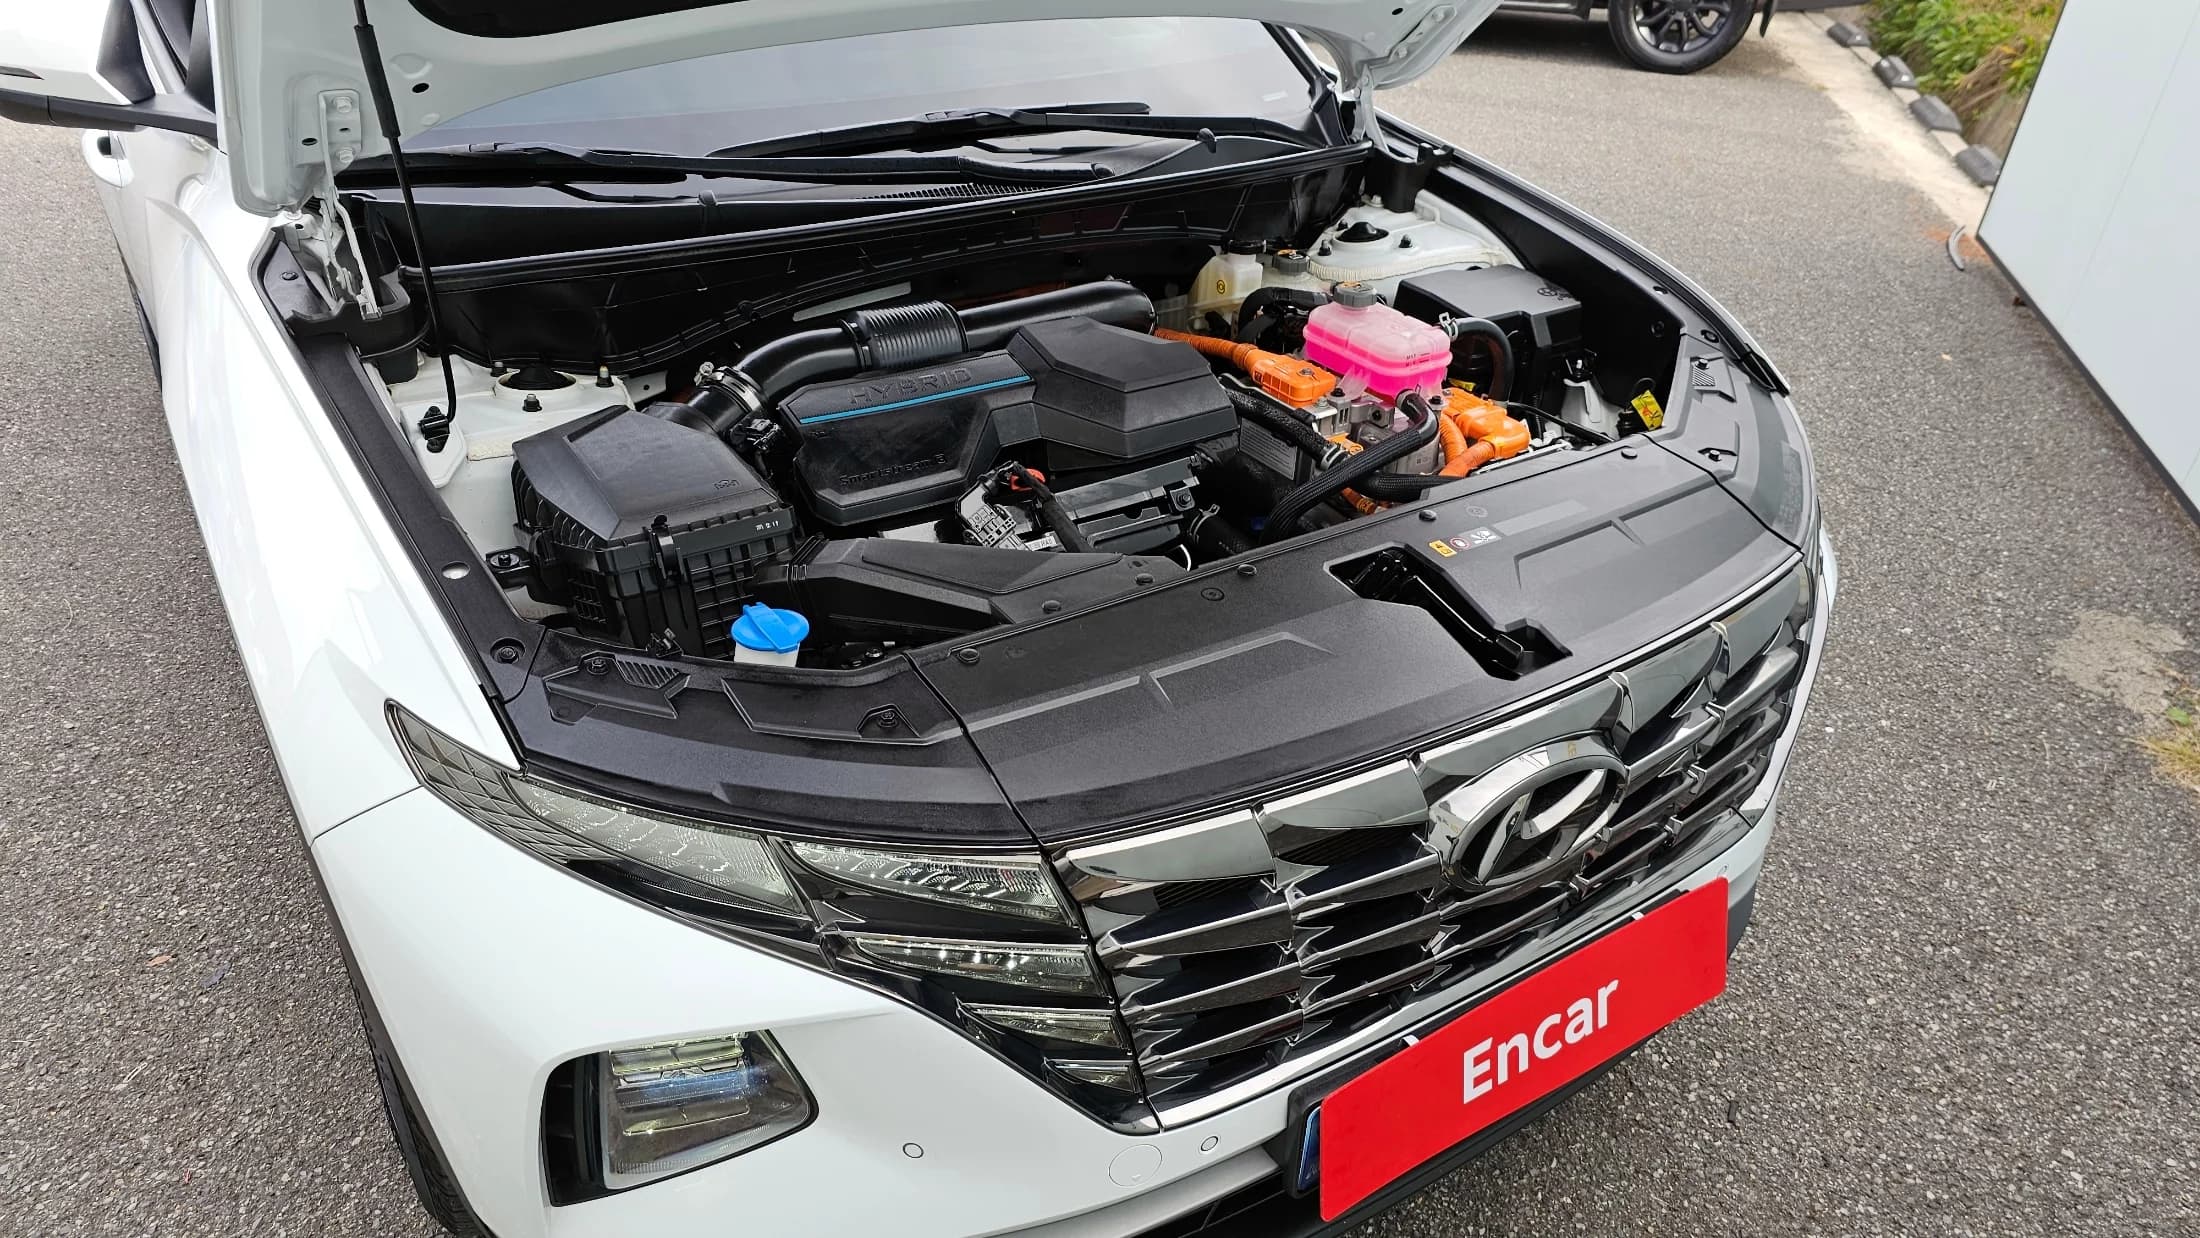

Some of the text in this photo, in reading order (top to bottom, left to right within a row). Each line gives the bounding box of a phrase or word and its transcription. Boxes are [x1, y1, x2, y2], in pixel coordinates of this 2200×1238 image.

[847, 367, 972, 404] HYBRID
[838, 459, 930, 487] Smartstream
[1462, 979, 1619, 1105] Encar
